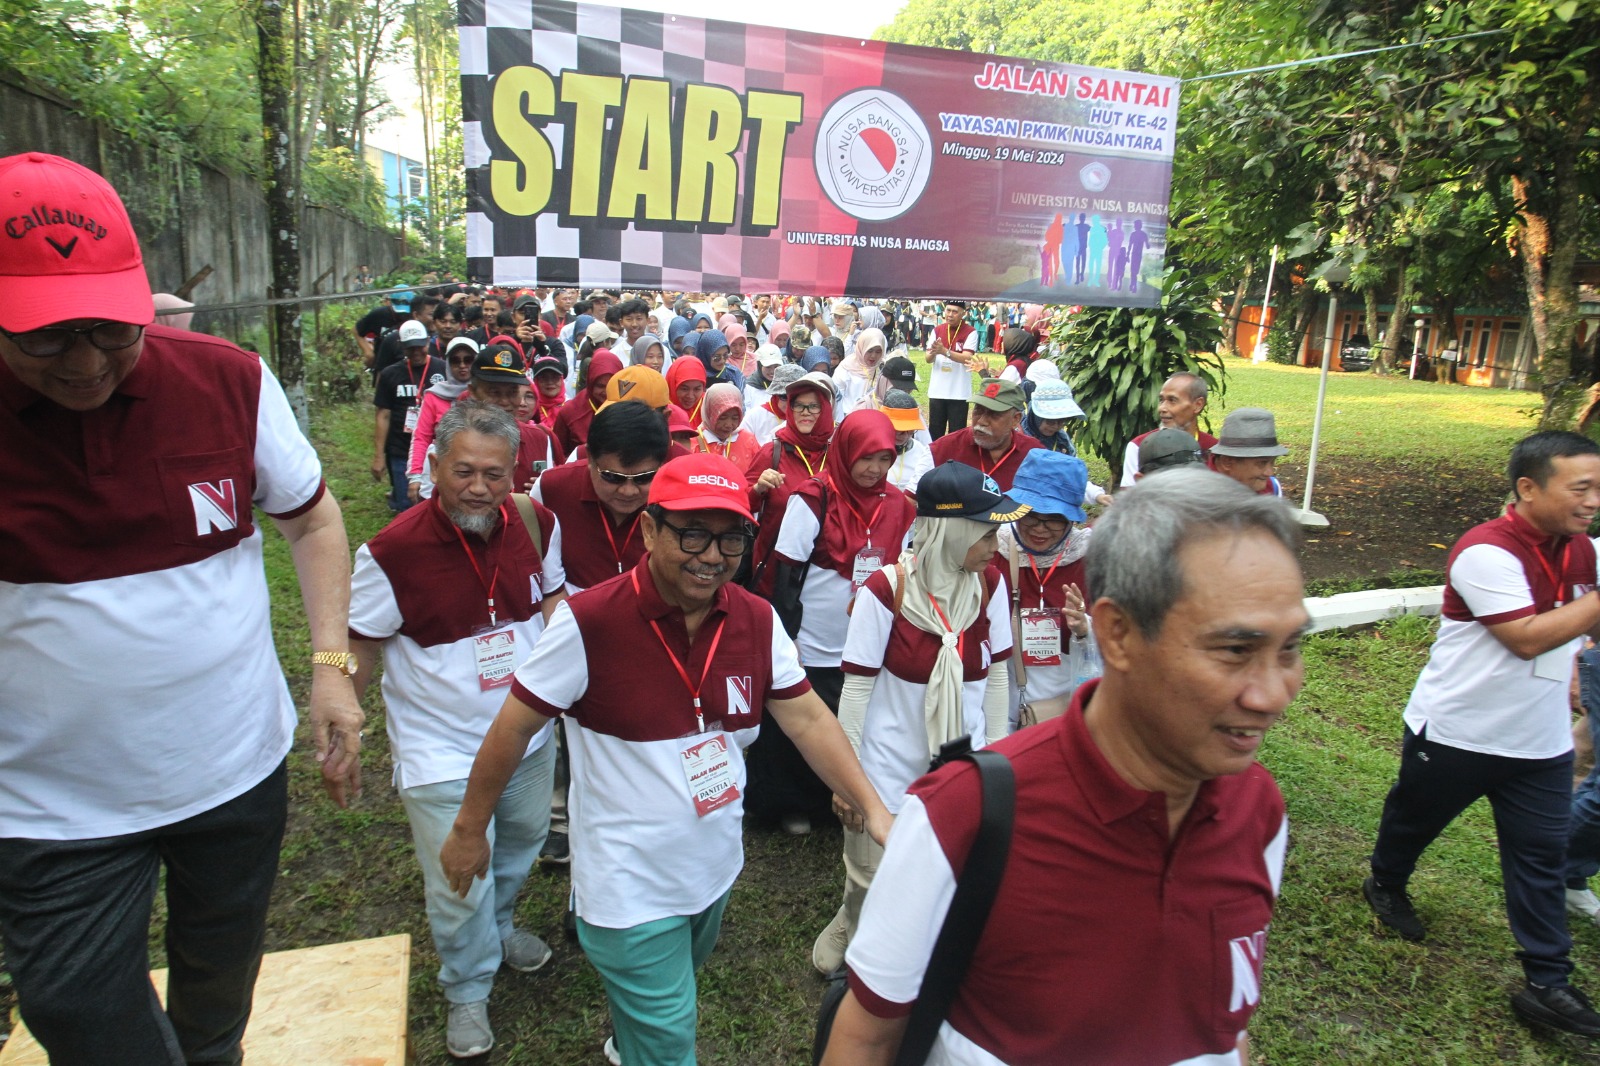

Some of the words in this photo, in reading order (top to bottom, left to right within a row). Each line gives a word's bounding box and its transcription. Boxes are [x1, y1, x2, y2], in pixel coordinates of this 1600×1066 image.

[976, 63, 1069, 98] JALAN
[1075, 76, 1172, 108] SANTAI
[1091, 108, 1122, 126] HUT
[1126, 113, 1168, 131] KE-42
[838, 117, 866, 152] NUSA
[868, 113, 909, 157] BANGSA
[940, 114, 1018, 136] YAYASAN
[1022, 123, 1070, 142] PKMK
[1072, 128, 1163, 151] NUSANTARA
[489, 64, 803, 227] START
[942, 142, 991, 162] Minggu,
[994, 147, 1009, 161] 19
[1011, 149, 1034, 164] Mei
[1036, 151, 1065, 166] 2024
[839, 163, 906, 197] UNIVERSITAS
[1011, 192, 1088, 210] UNIVERSITAS
[1092, 199, 1123, 213] NUSA
[1127, 202, 1169, 216] BANGSA
[5, 204, 108, 241] Callaway
[787, 231, 867, 247] UNIVERSITAS
[870, 236, 902, 249] NUSA
[905, 238, 950, 252] BANGSA
[688, 475, 740, 490] BBSDLP
[484, 667, 512, 678] PANITIA
[699, 781, 729, 800] PANITIA
